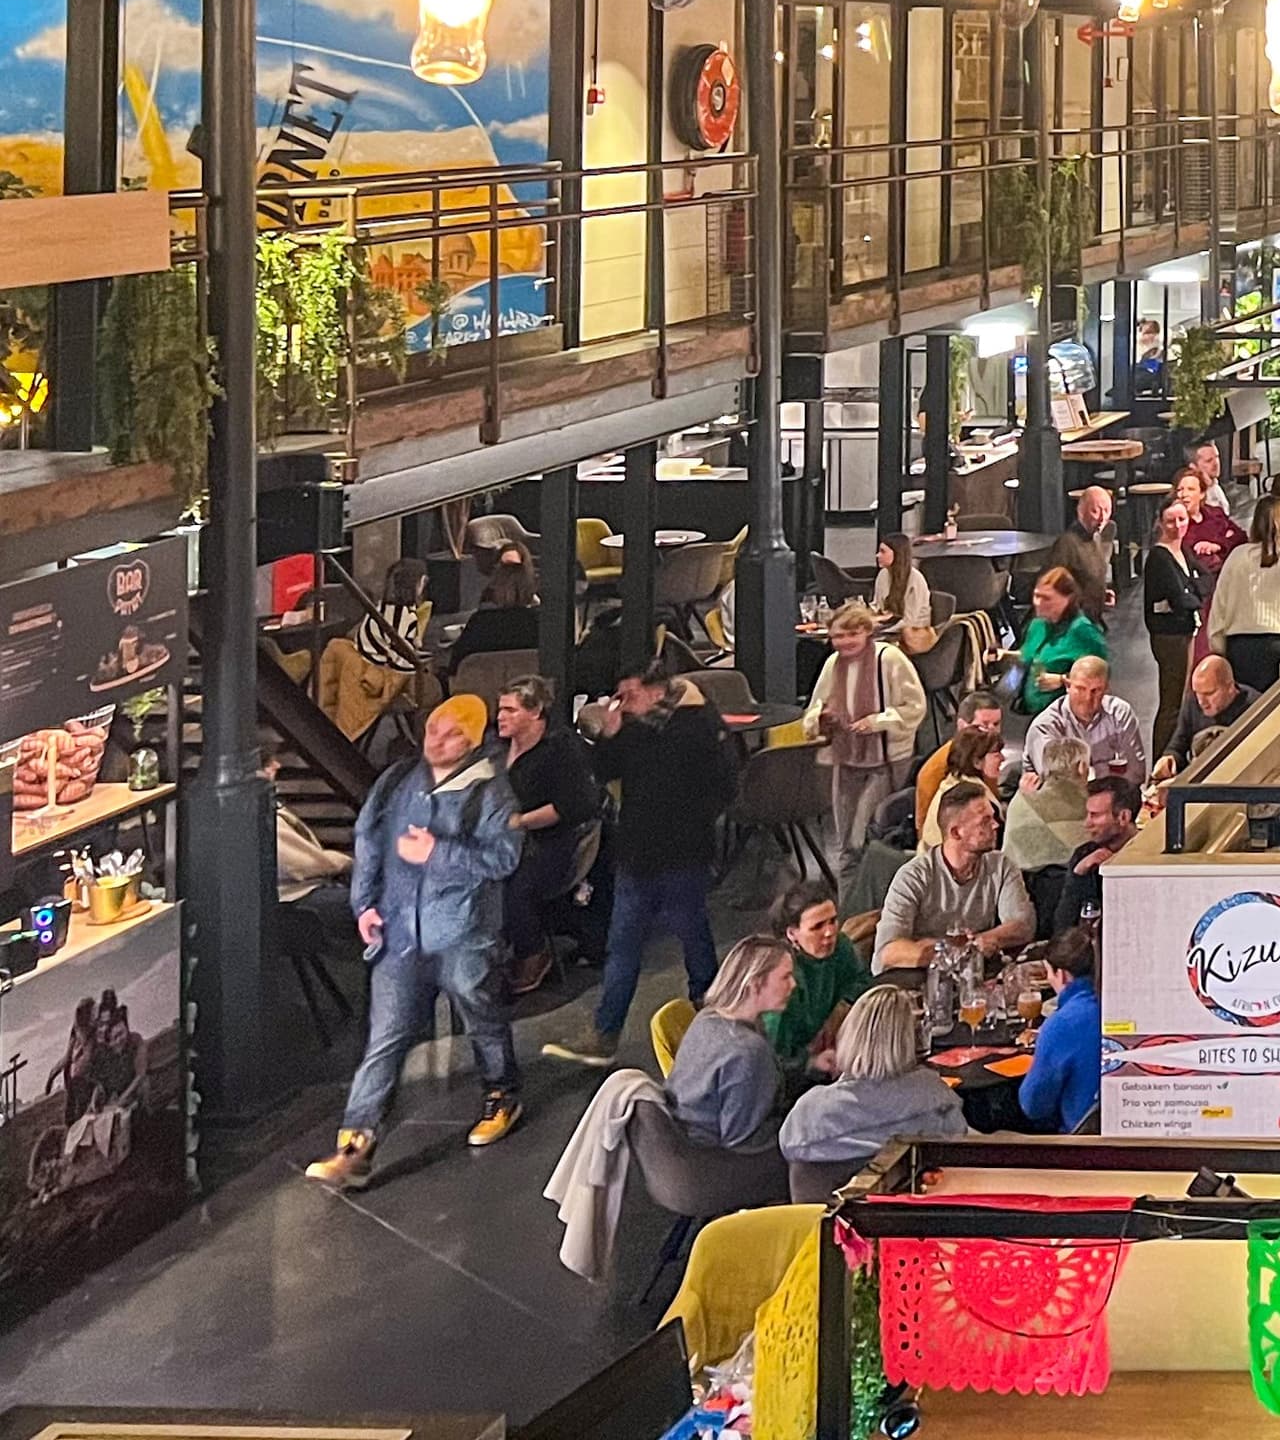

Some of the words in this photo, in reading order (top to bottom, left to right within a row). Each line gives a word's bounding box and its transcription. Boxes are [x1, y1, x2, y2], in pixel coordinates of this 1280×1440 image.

[116, 568, 143, 596] BAR
[1199, 1048, 1235, 1064] BITES
[1242, 1048, 1257, 1063] TO
[1121, 1082, 1171, 1092] Gebakken
[1122, 1098, 1140, 1108] Trio
[1120, 1120, 1162, 1129] Chicken
[1164, 1120, 1192, 1130] wings
